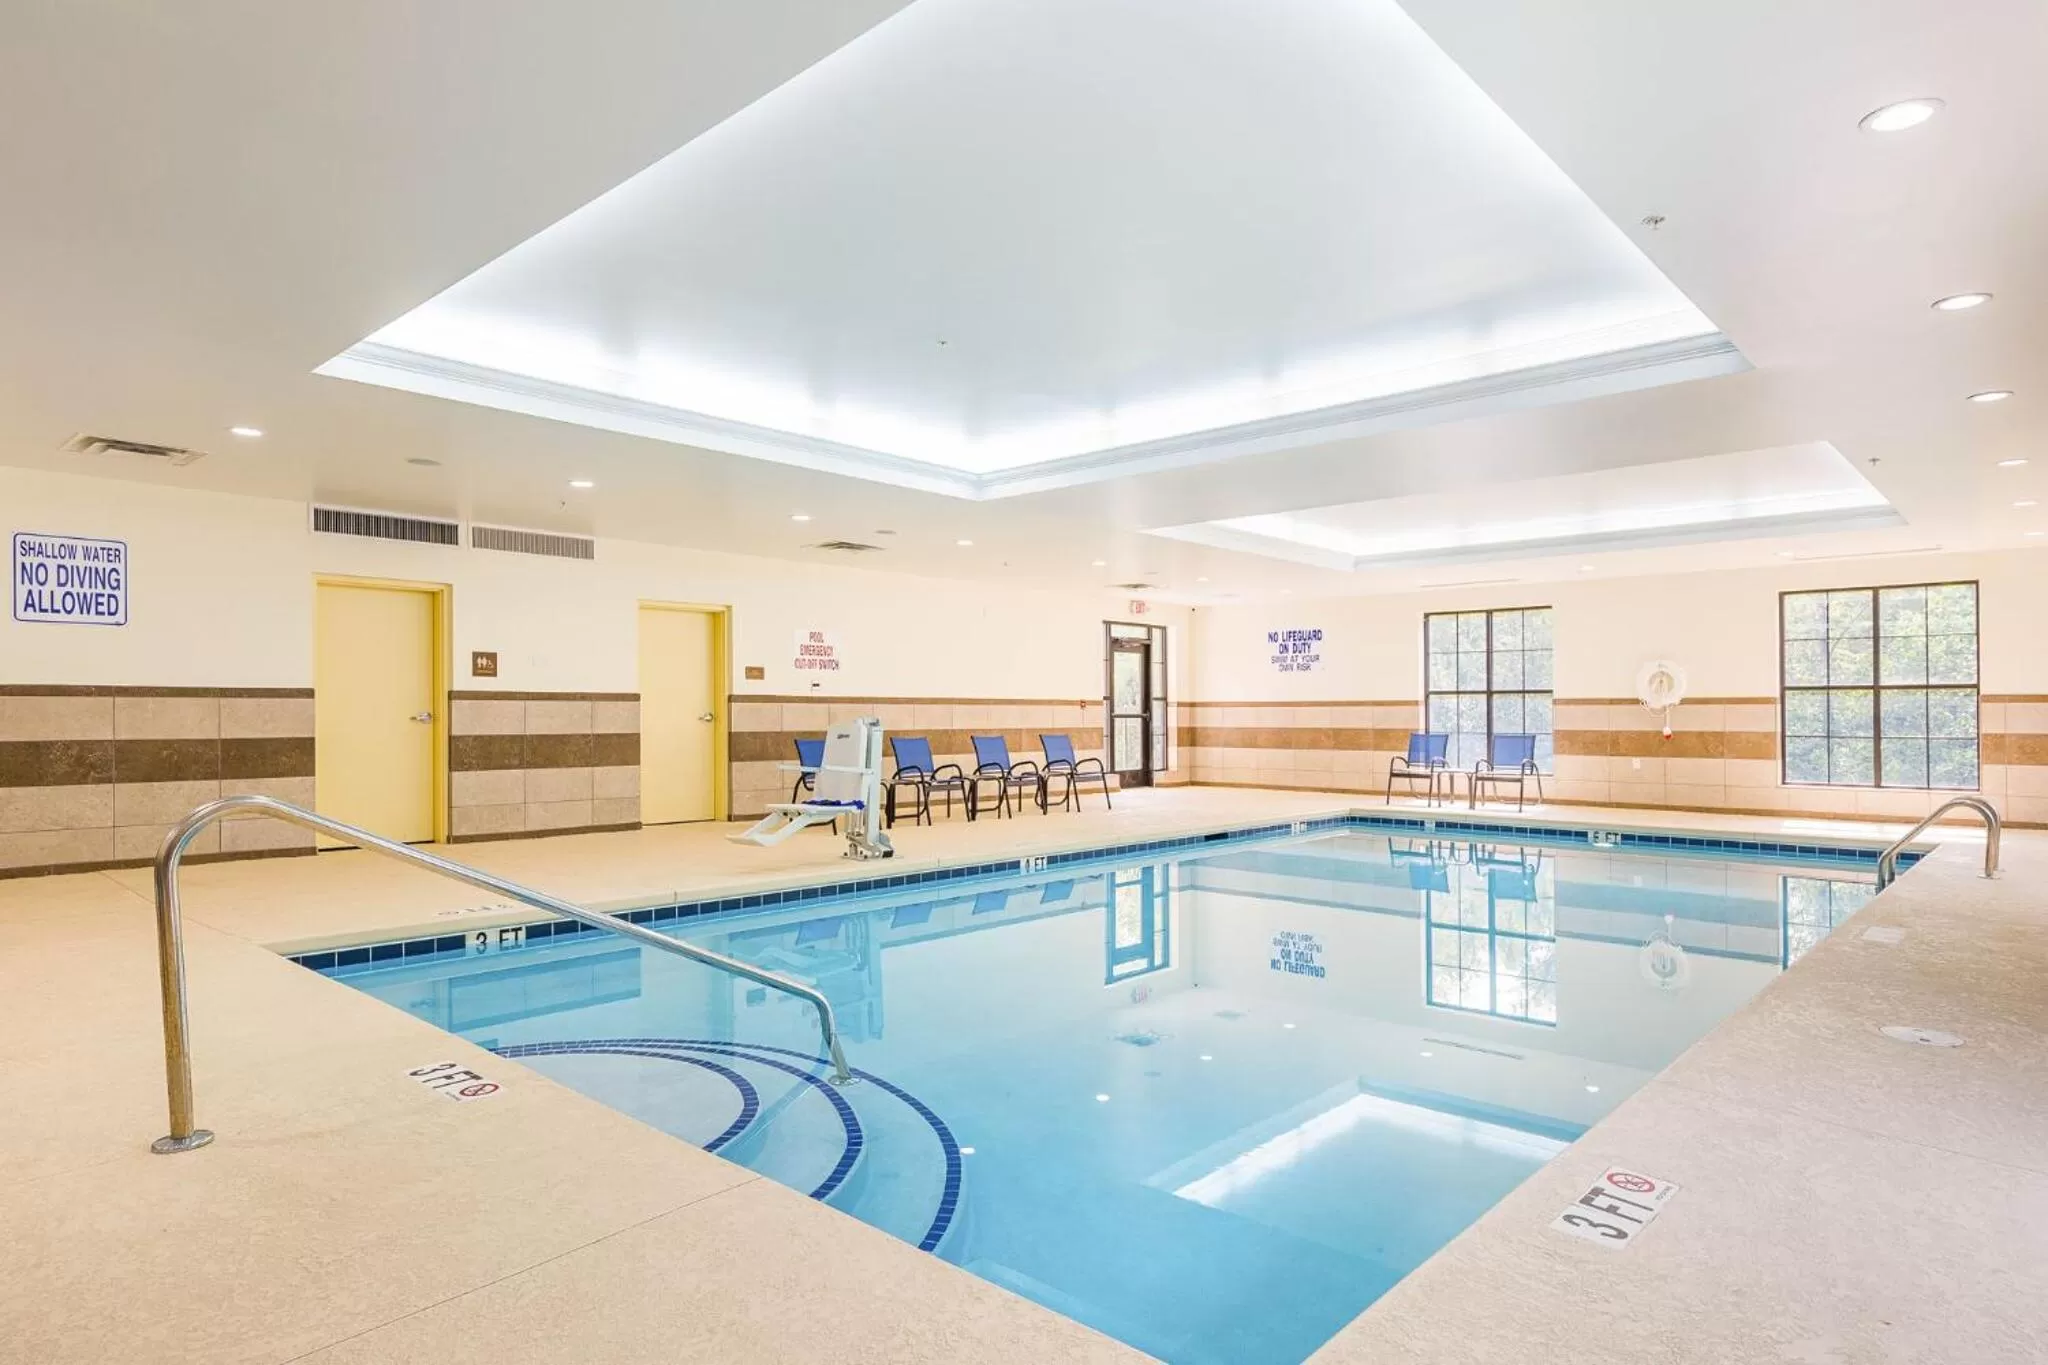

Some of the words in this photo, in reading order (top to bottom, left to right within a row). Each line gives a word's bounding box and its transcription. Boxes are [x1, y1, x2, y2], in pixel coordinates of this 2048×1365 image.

[20, 540, 77, 560] SHALLOW
[82, 545, 121, 564] WATER
[21, 562, 48, 586] NO
[57, 564, 120, 590] DIVING
[24, 589, 119, 616] ALLOWED
[809, 631, 824, 643] POOL
[1268, 631, 1279, 643] NO
[1282, 629, 1322, 642] LIFEGUARD
[799, 644, 834, 657] EMERGENCY
[1279, 643, 1289, 654] ON
[1293, 642, 1311, 654] DUTY
[818, 659, 840, 671] SWITCH
[1290, 654, 1299, 663] AT
[1302, 654, 1320, 663] YOUR
[1279, 663, 1293, 672] OWN
[1296, 662, 1312, 671] RISK
[1605, 832, 1619, 845] FT
[1035, 857, 1045, 872] FT
[499, 926, 523, 949] FT
[409, 1063, 457, 1076] 3
[422, 1070, 483, 1089] FT
[1579, 1186, 1654, 1224] FT
[1562, 1214, 1628, 1240] 3
